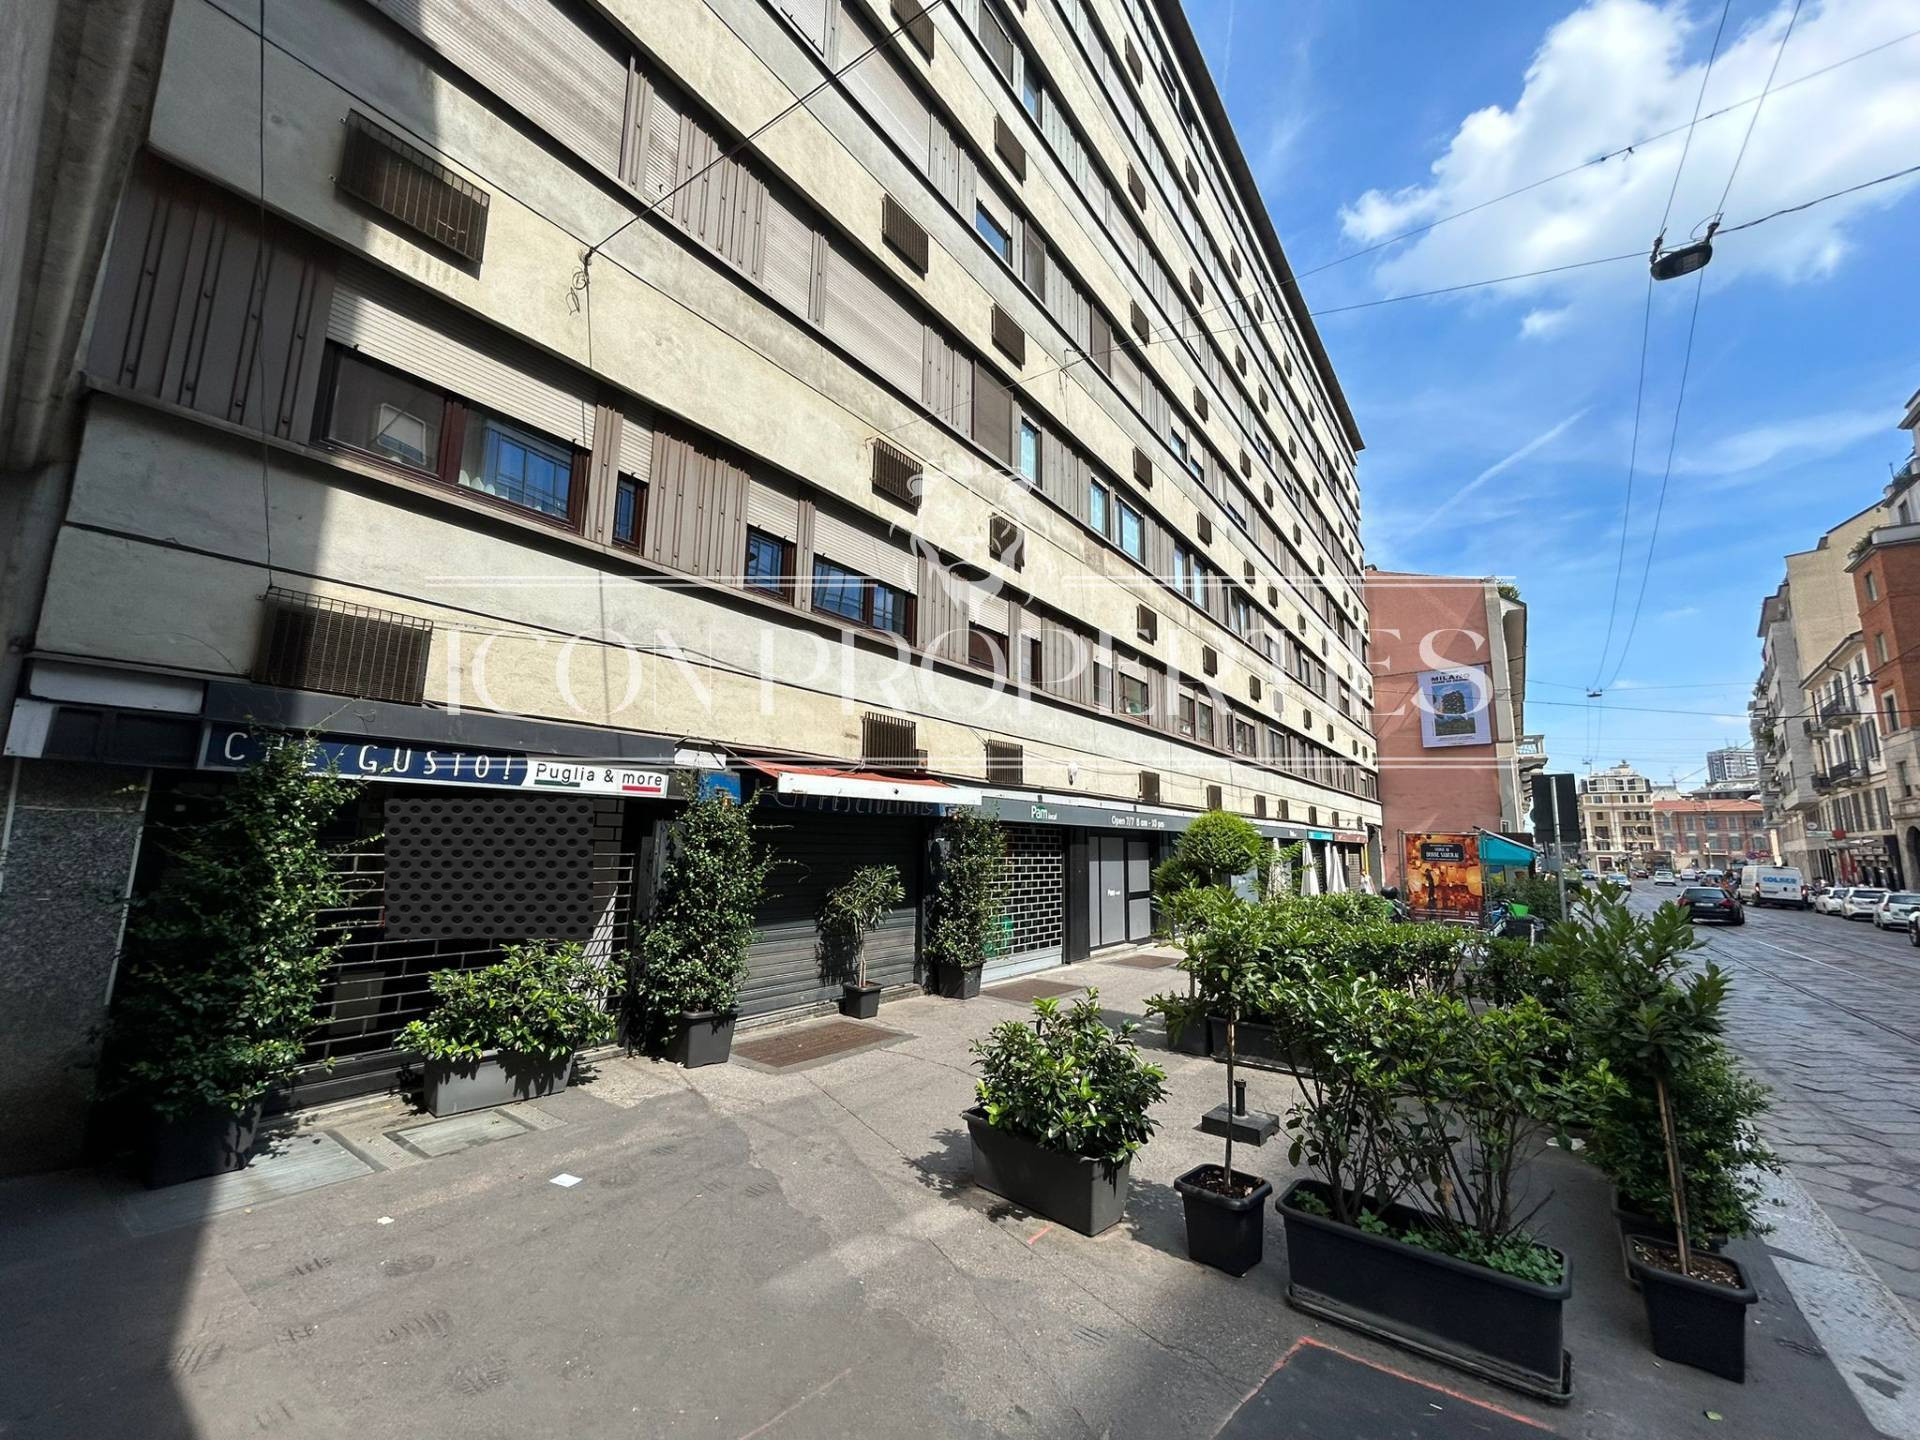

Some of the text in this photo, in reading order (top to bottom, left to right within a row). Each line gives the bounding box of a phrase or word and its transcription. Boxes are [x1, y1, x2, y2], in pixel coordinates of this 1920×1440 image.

[358, 744, 512, 780] GUSTO!
[536, 763, 663, 787] Puglia & more
[1031, 805, 1048, 819] Pam
[1111, 815, 1126, 827] Open
